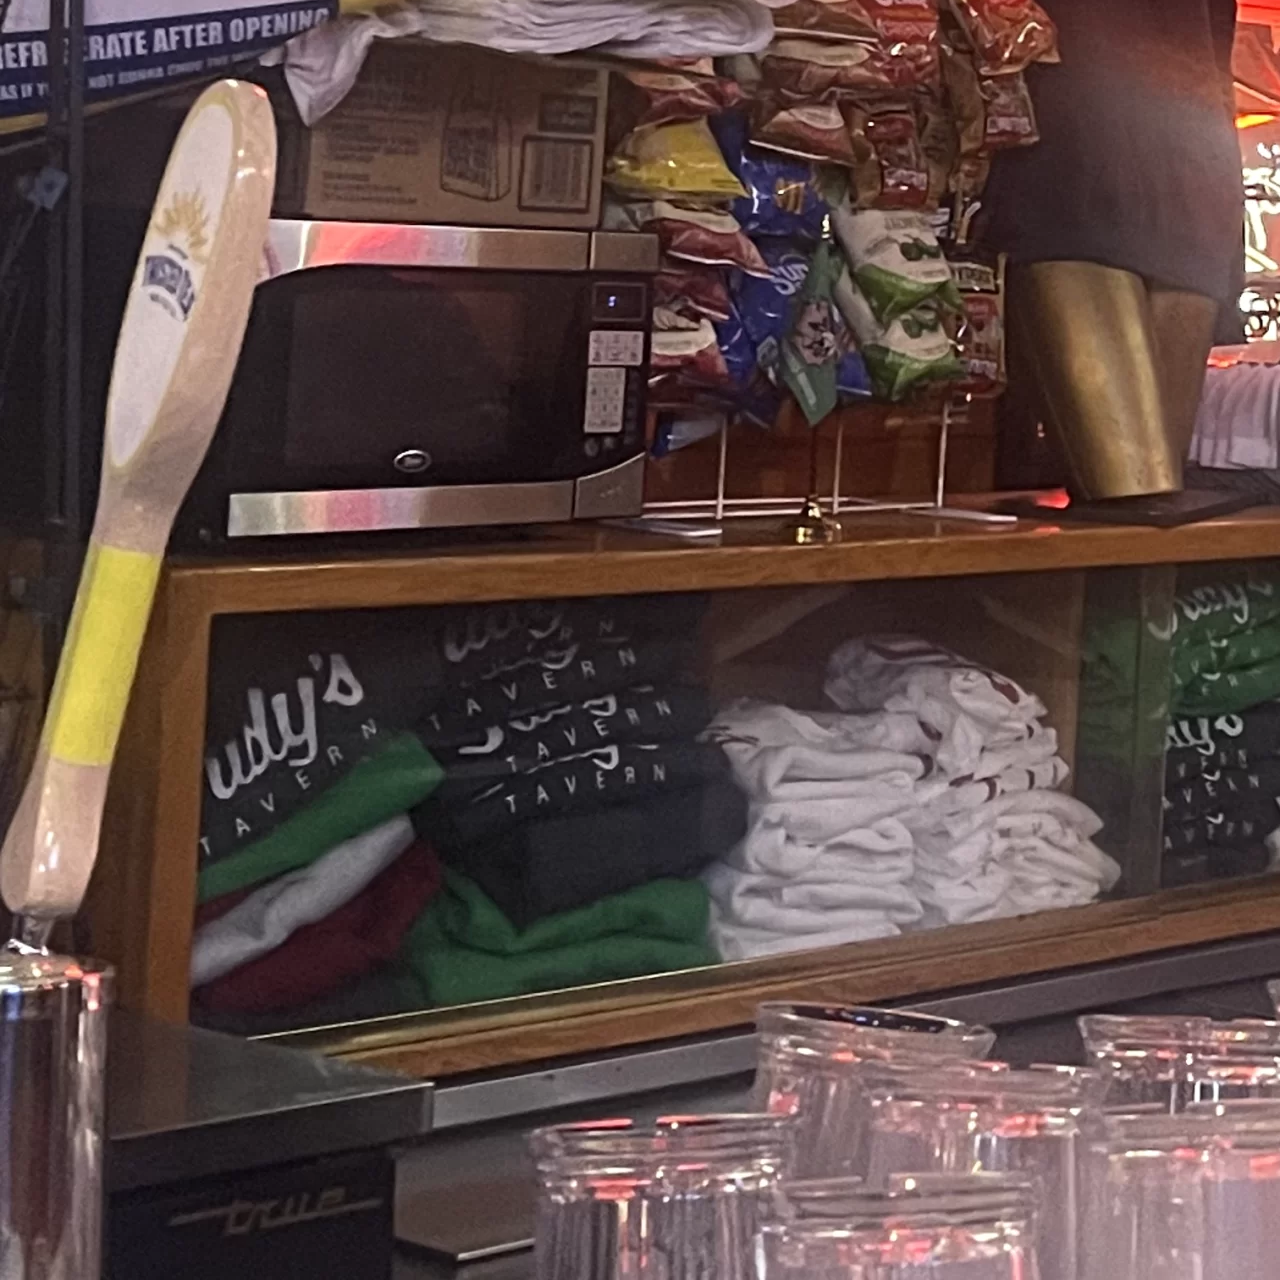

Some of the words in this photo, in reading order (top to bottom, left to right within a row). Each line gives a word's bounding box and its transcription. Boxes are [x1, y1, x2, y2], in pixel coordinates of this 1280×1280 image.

[153, 21, 223, 54] AFTER
[206, 652, 365, 800] udy's
[505, 699, 672, 772] TAVERN
[199, 717, 378, 856] TAVERN
[504, 763, 667, 814] TAVERN
